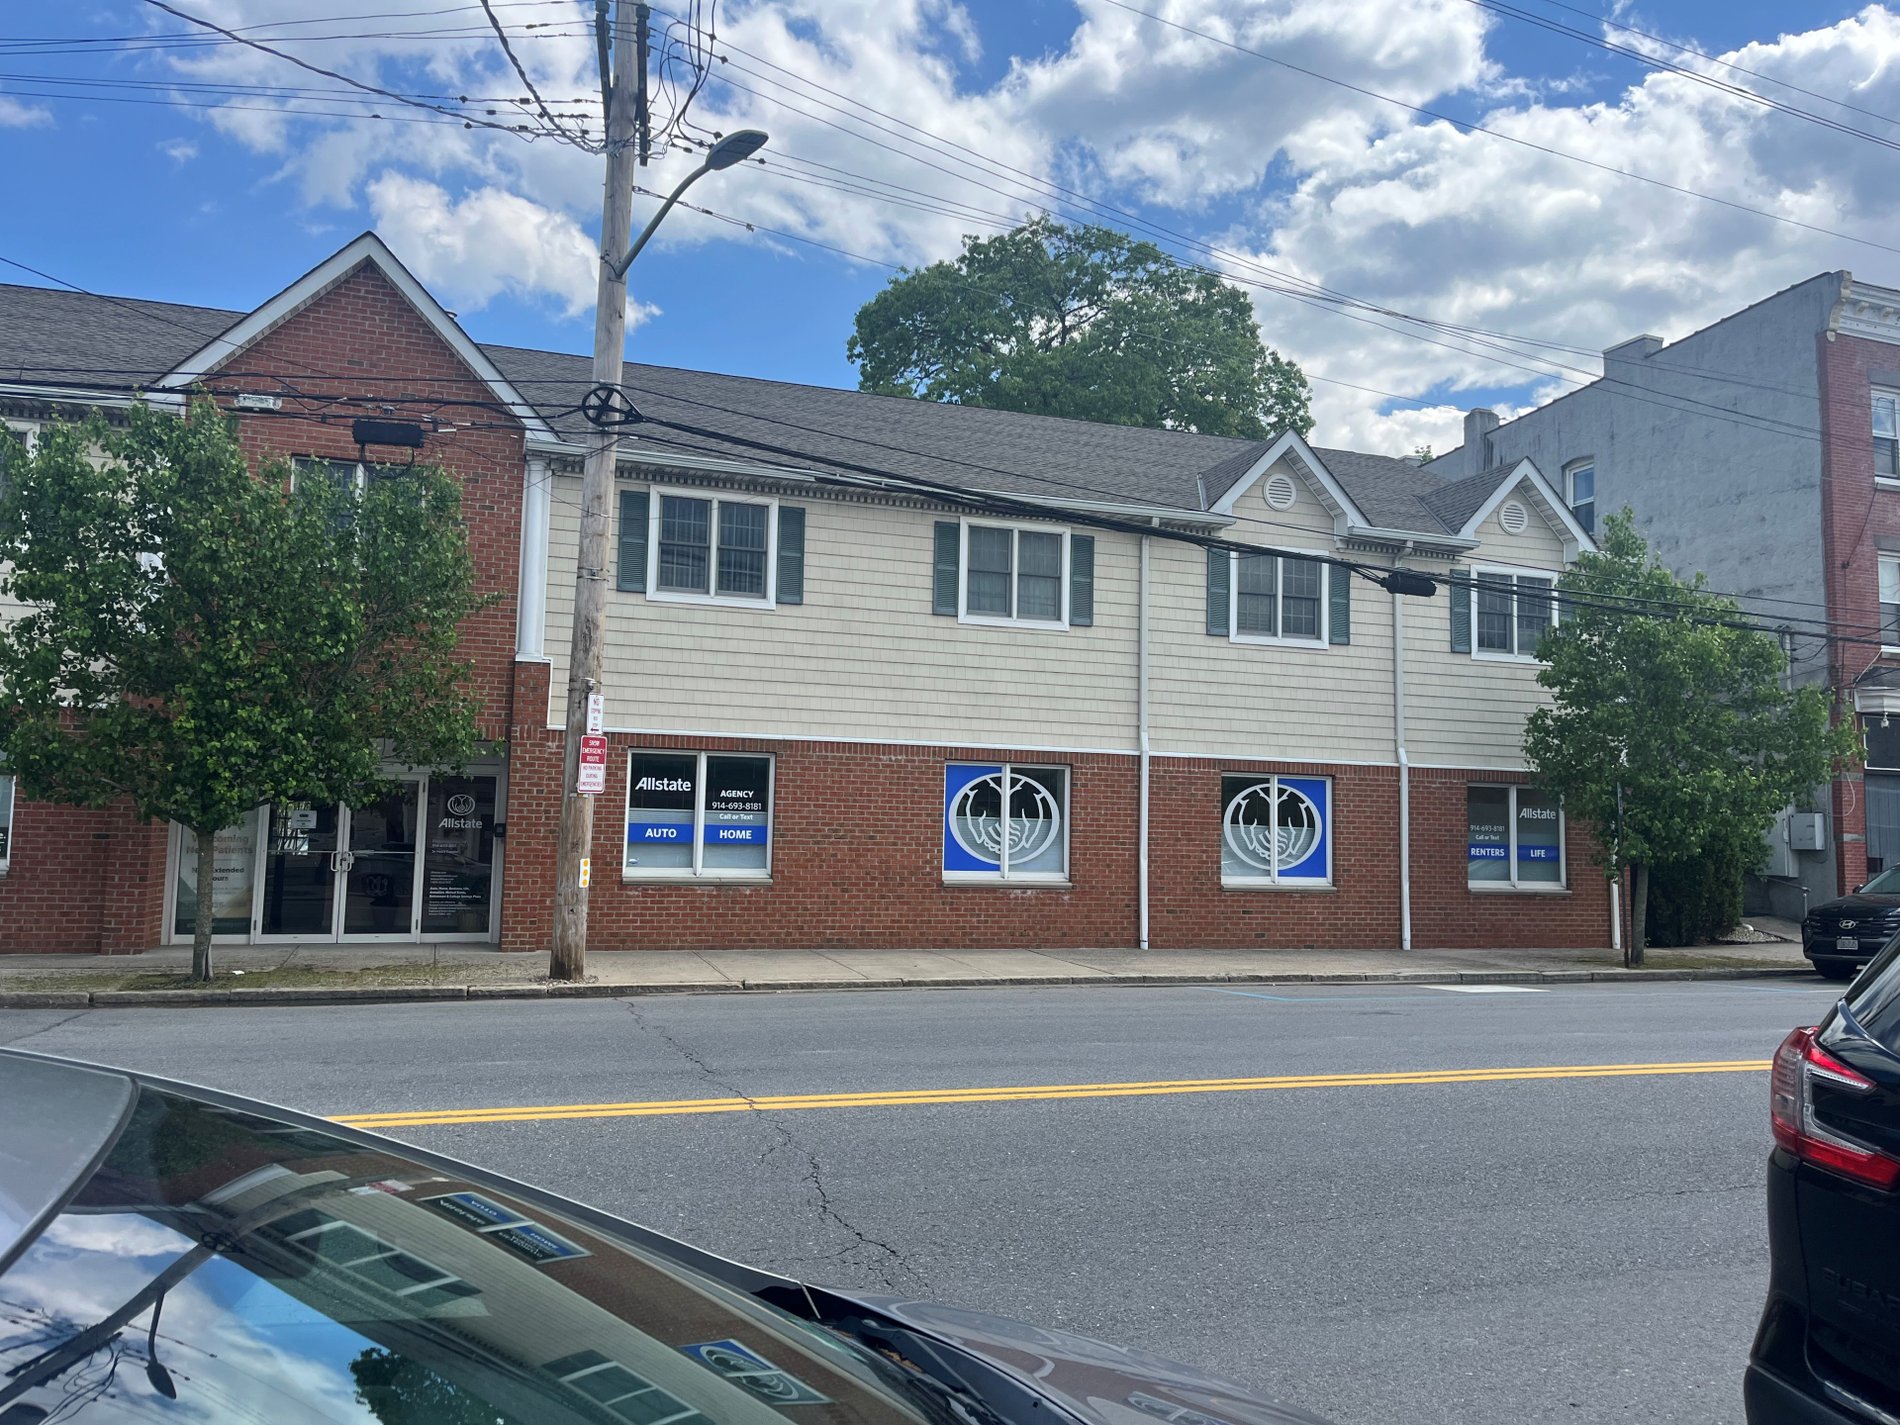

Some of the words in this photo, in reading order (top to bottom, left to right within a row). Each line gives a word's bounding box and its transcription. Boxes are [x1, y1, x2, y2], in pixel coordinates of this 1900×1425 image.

[635, 777, 692, 791] Allstate
[720, 790, 754, 798] AGENCY
[712, 802, 762, 811] 914-693-8181
[1519, 807, 1557, 820] Allstate
[438, 818, 483, 829] Allstate
[645, 828, 677, 838] AUTO
[719, 830, 752, 839] HOME
[1470, 847, 1505, 857] RENTERS
[1530, 849, 1546, 858] LIFE
